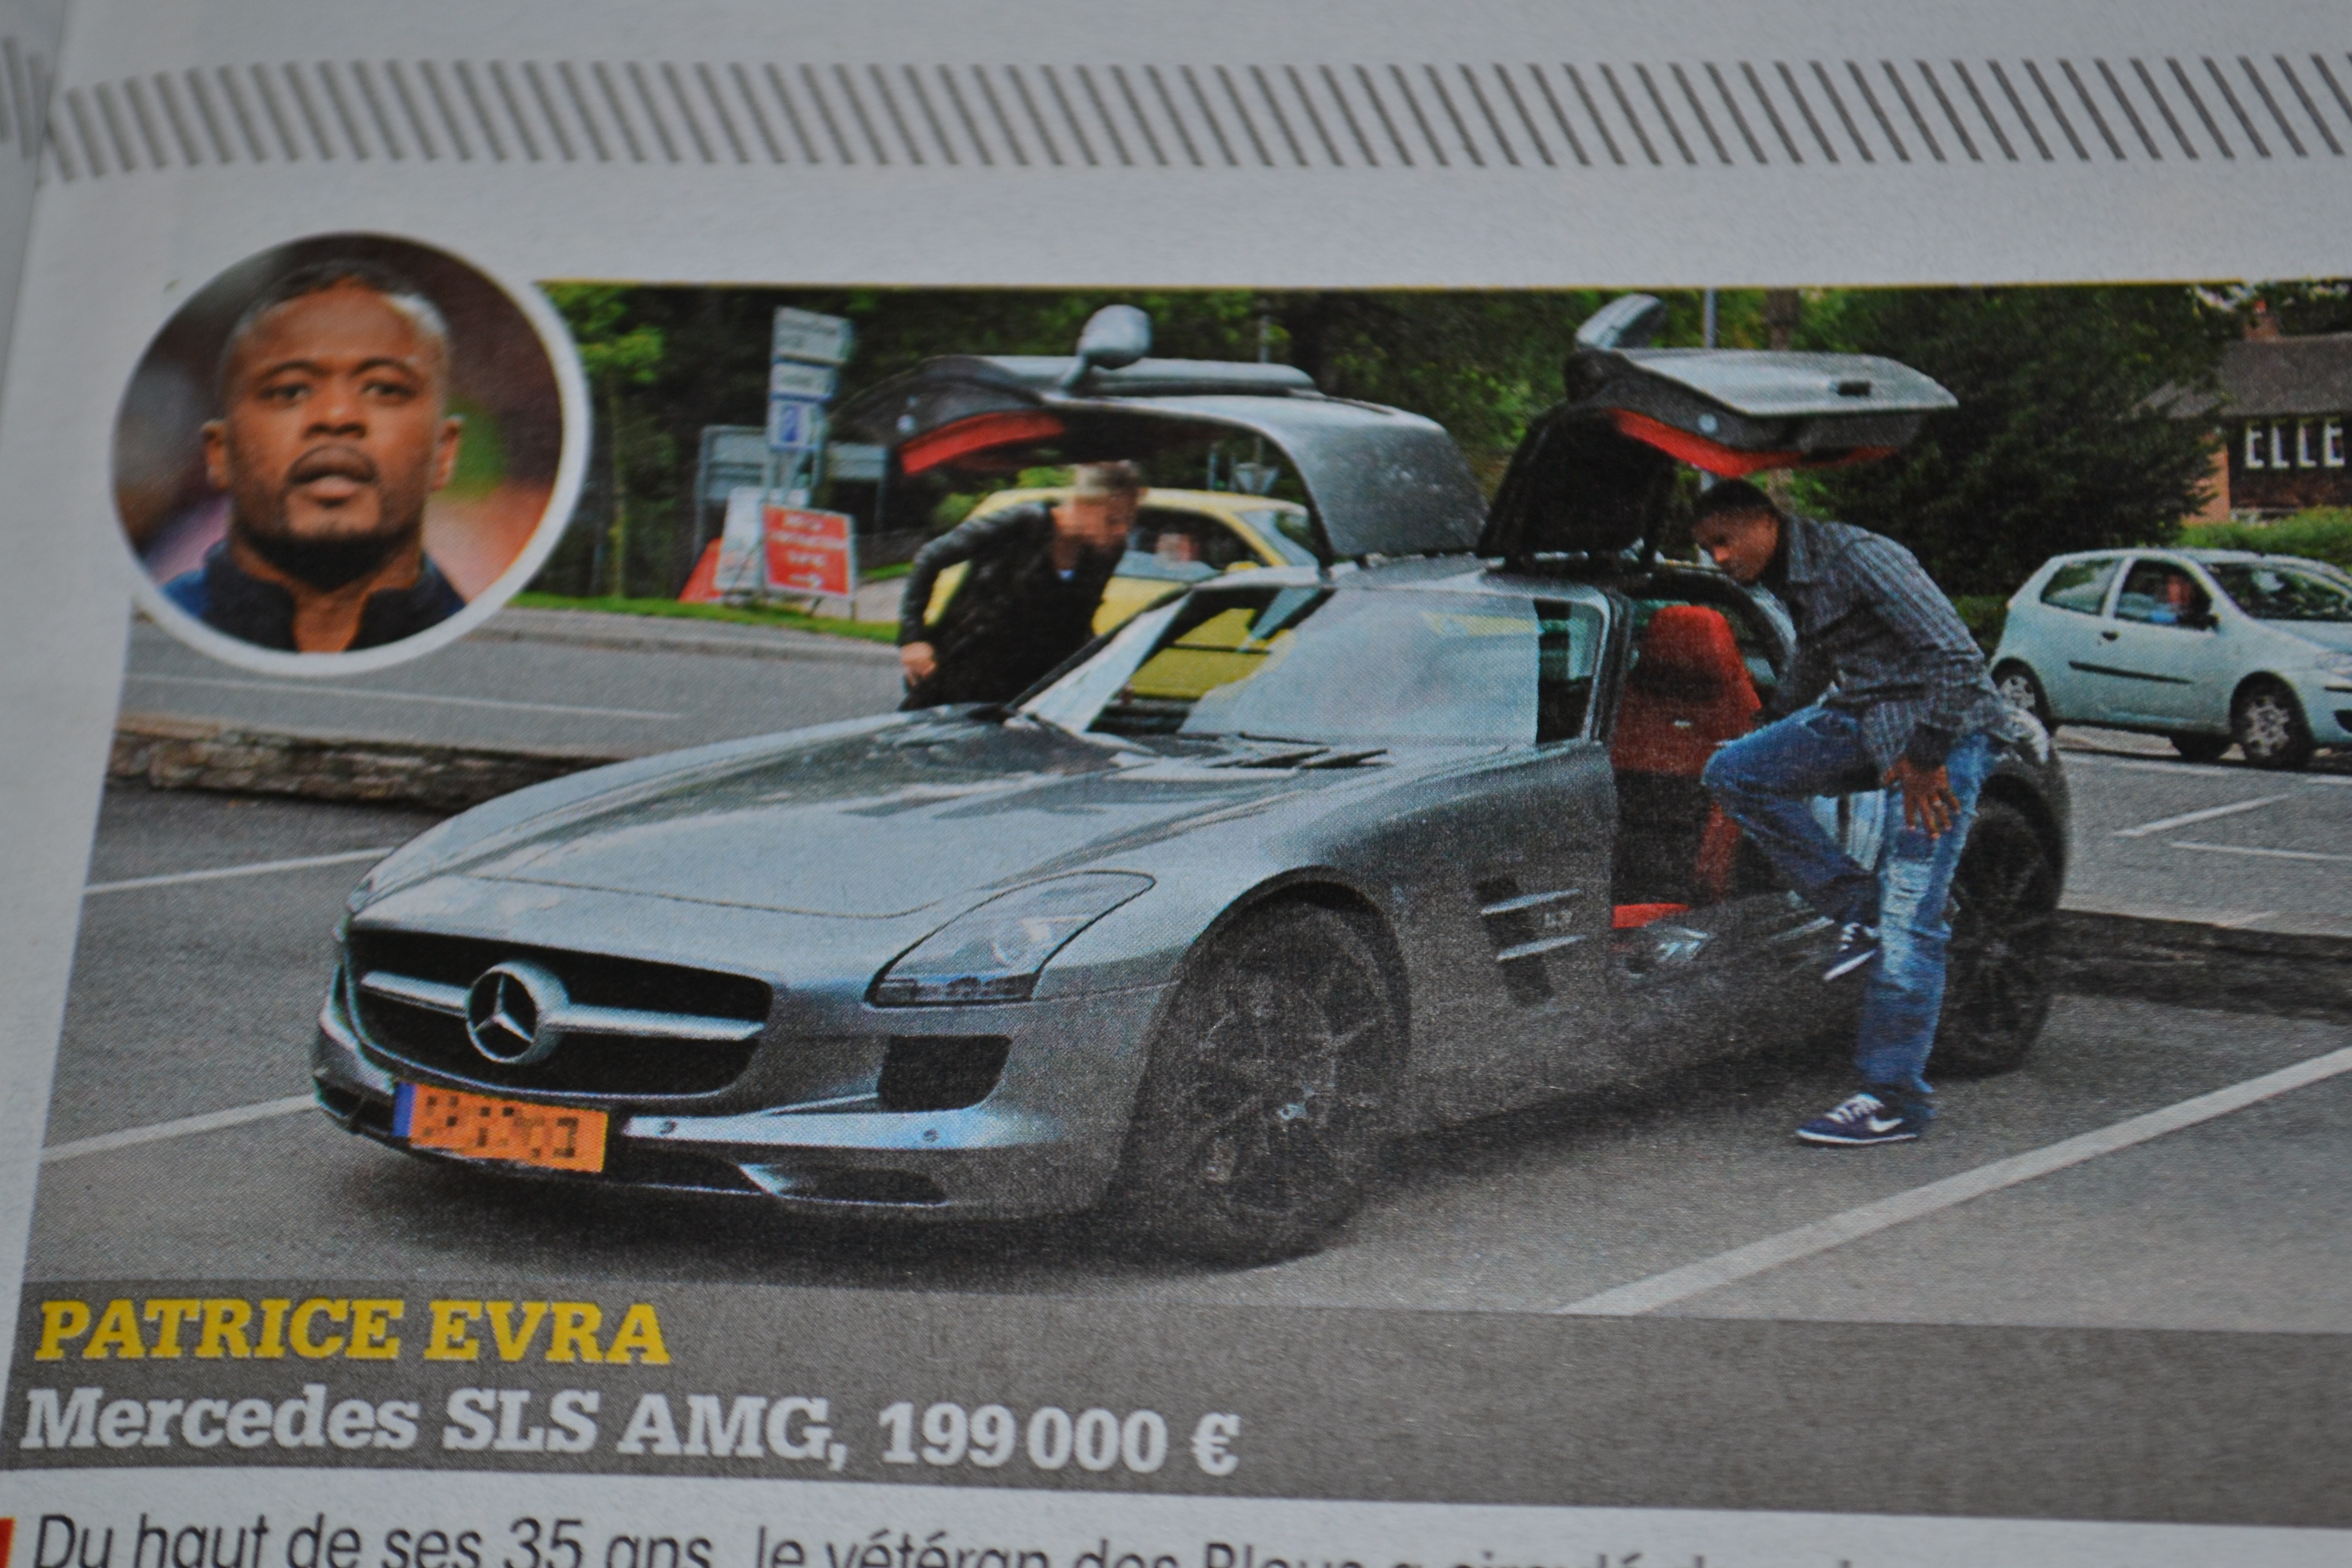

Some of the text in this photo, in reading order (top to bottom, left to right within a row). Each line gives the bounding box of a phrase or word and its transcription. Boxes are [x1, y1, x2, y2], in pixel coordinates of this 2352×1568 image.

[34, 1298, 672, 1365] PATRICE EVRA
[20, 1384, 420, 1449] Mercedes
[443, 1388, 601, 1453] SLS
[616, 1393, 848, 1472] AMG,
[1189, 1412, 1242, 1477] €
[33, 1513, 114, 1568] Du
[133, 1512, 270, 1568] haut
[286, 1512, 362, 1568] de
[381, 1528, 482, 1568] ses
[503, 1516, 583, 1568] 35
